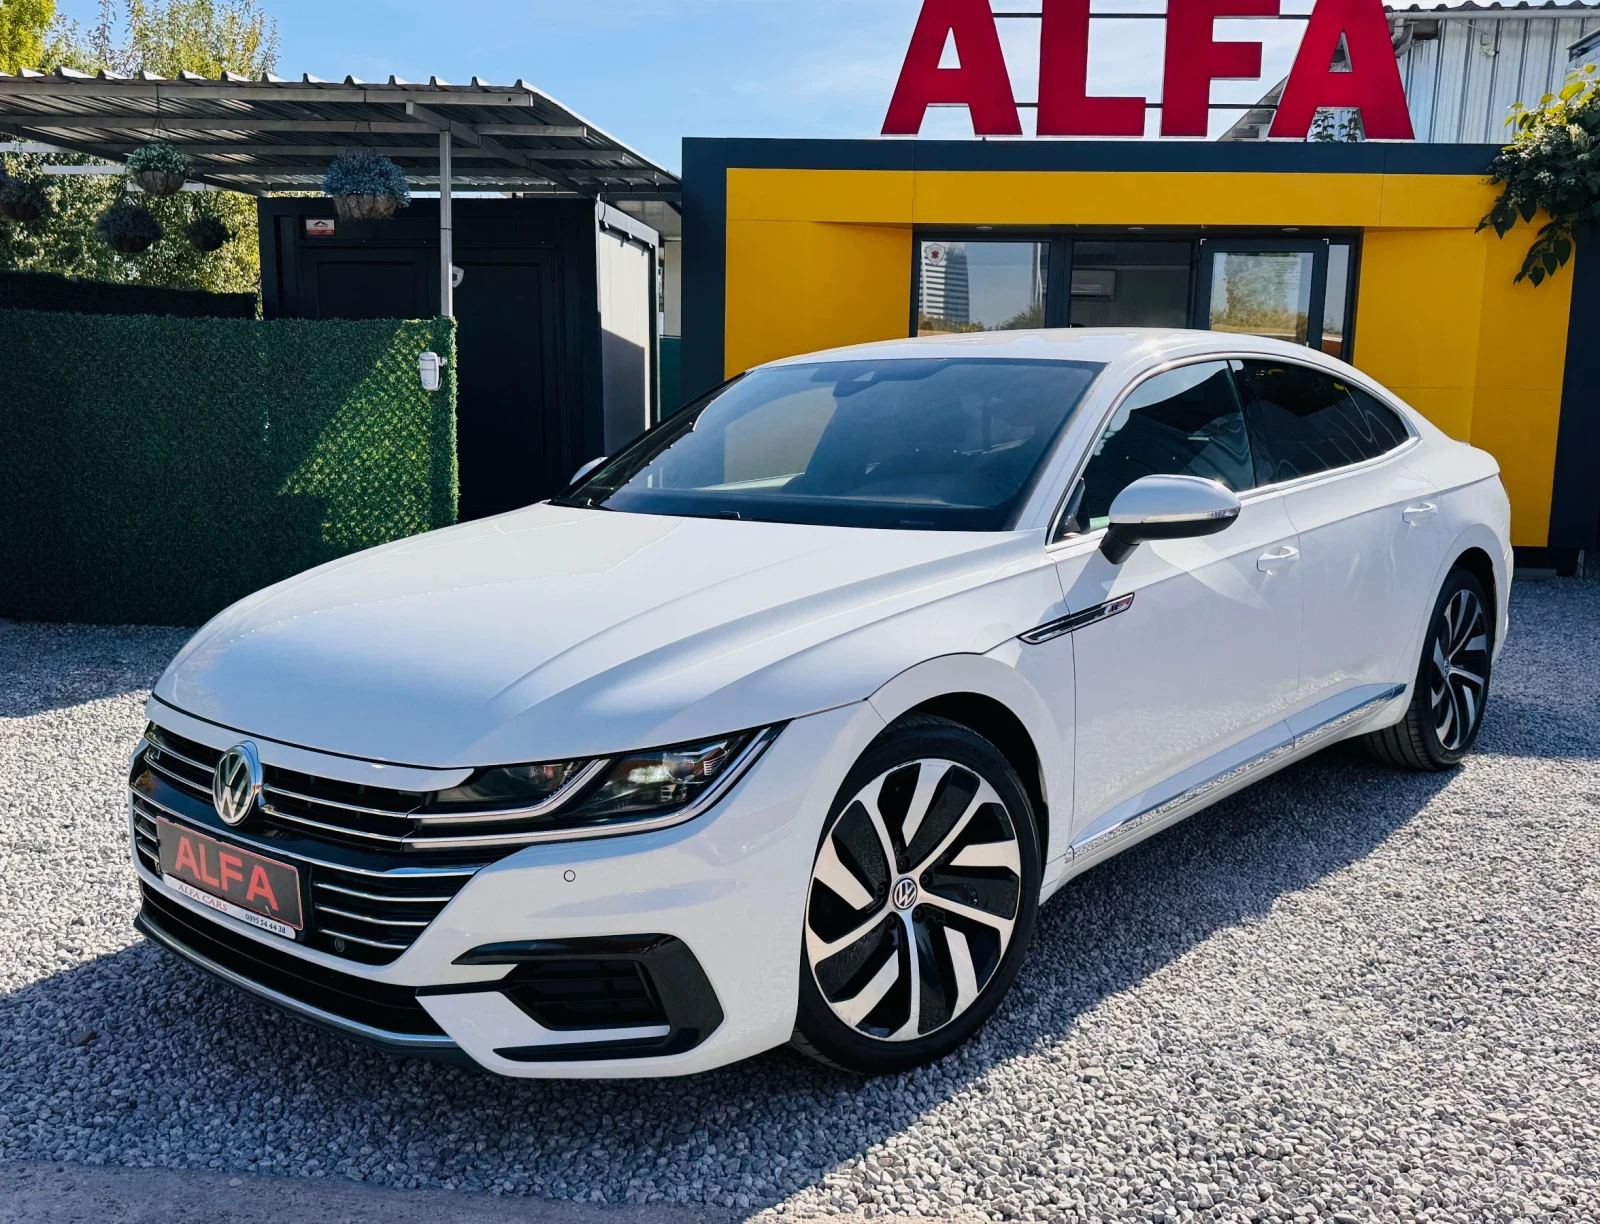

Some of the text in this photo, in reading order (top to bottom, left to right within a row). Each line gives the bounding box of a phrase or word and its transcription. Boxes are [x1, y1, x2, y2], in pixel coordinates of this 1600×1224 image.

[881, 0, 1415, 139] ALFA
[175, 836, 279, 911] ALFA
[178, 885, 228, 912] ALFA CARS
[260, 919, 268, 928] 54
[269, 923, 277, 931] 44
[278, 926, 286, 934] 38
